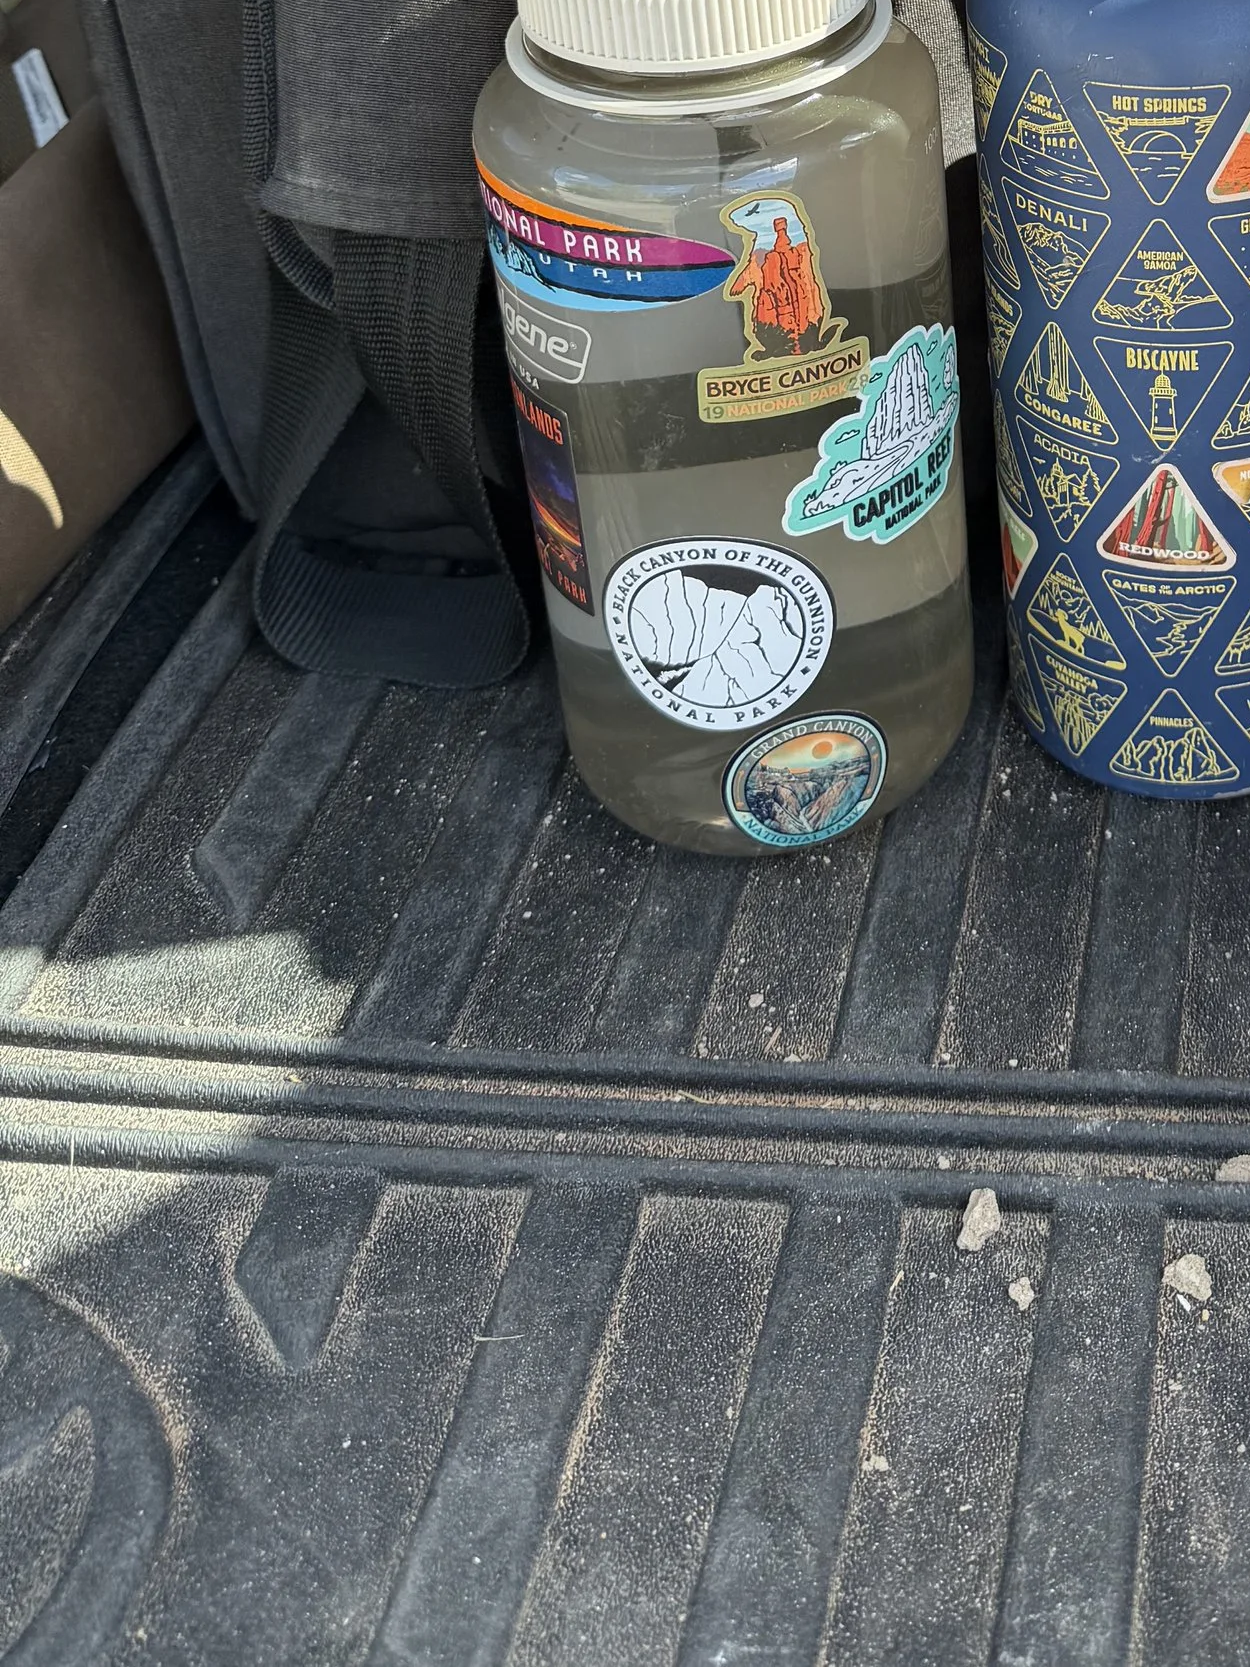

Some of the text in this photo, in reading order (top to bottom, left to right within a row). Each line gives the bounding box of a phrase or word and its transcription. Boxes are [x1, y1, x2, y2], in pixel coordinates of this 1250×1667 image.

[1023, 100, 1063, 122] TORTUGAS
[1029, 91, 1053, 108] DRY
[1112, 95, 1208, 114] HOT SPRINGS
[480, 182, 643, 264] TIONAL PARK
[1015, 193, 1088, 232] DENALI
[538, 252, 643, 282] UTAH
[1136, 250, 1184, 262] AMERICAN
[1143, 260, 1177, 271] SAMOA
[501, 288, 571, 365] lgene
[519, 363, 540, 390] USA
[706, 350, 862, 398] BRYCE CANYON
[1126, 347, 1200, 371] BISCAYNE
[511, 382, 563, 445] NLANDS
[703, 404, 725, 420] 19
[727, 397, 804, 418] NATIONAL
[809, 384, 847, 402] PARK
[1024, 392, 1103, 437] CONGAREE
[1033, 433, 1091, 467] ACADIA
[852, 472, 923, 528] CAPITOL
[885, 473, 942, 531] NATIONAL PARK
[1118, 541, 1211, 561] REDWOOD
[1055, 570, 1077, 585] ROCKY
[1111, 578, 1156, 594] GATES
[1175, 584, 1226, 595] ARCTIC
[612, 548, 825, 661] BLACK CANYON OF THE GUNNISON
[616, 632, 798, 724] NATIONAL PARK
[1046, 654, 1099, 690] CUYAHOGA
[1055, 668, 1087, 694] VALLEY
[1150, 715, 1195, 729] PINNACLES
[751, 720, 874, 760] GRAND CANYON
[744, 807, 865, 845] NATIONAL PARK
